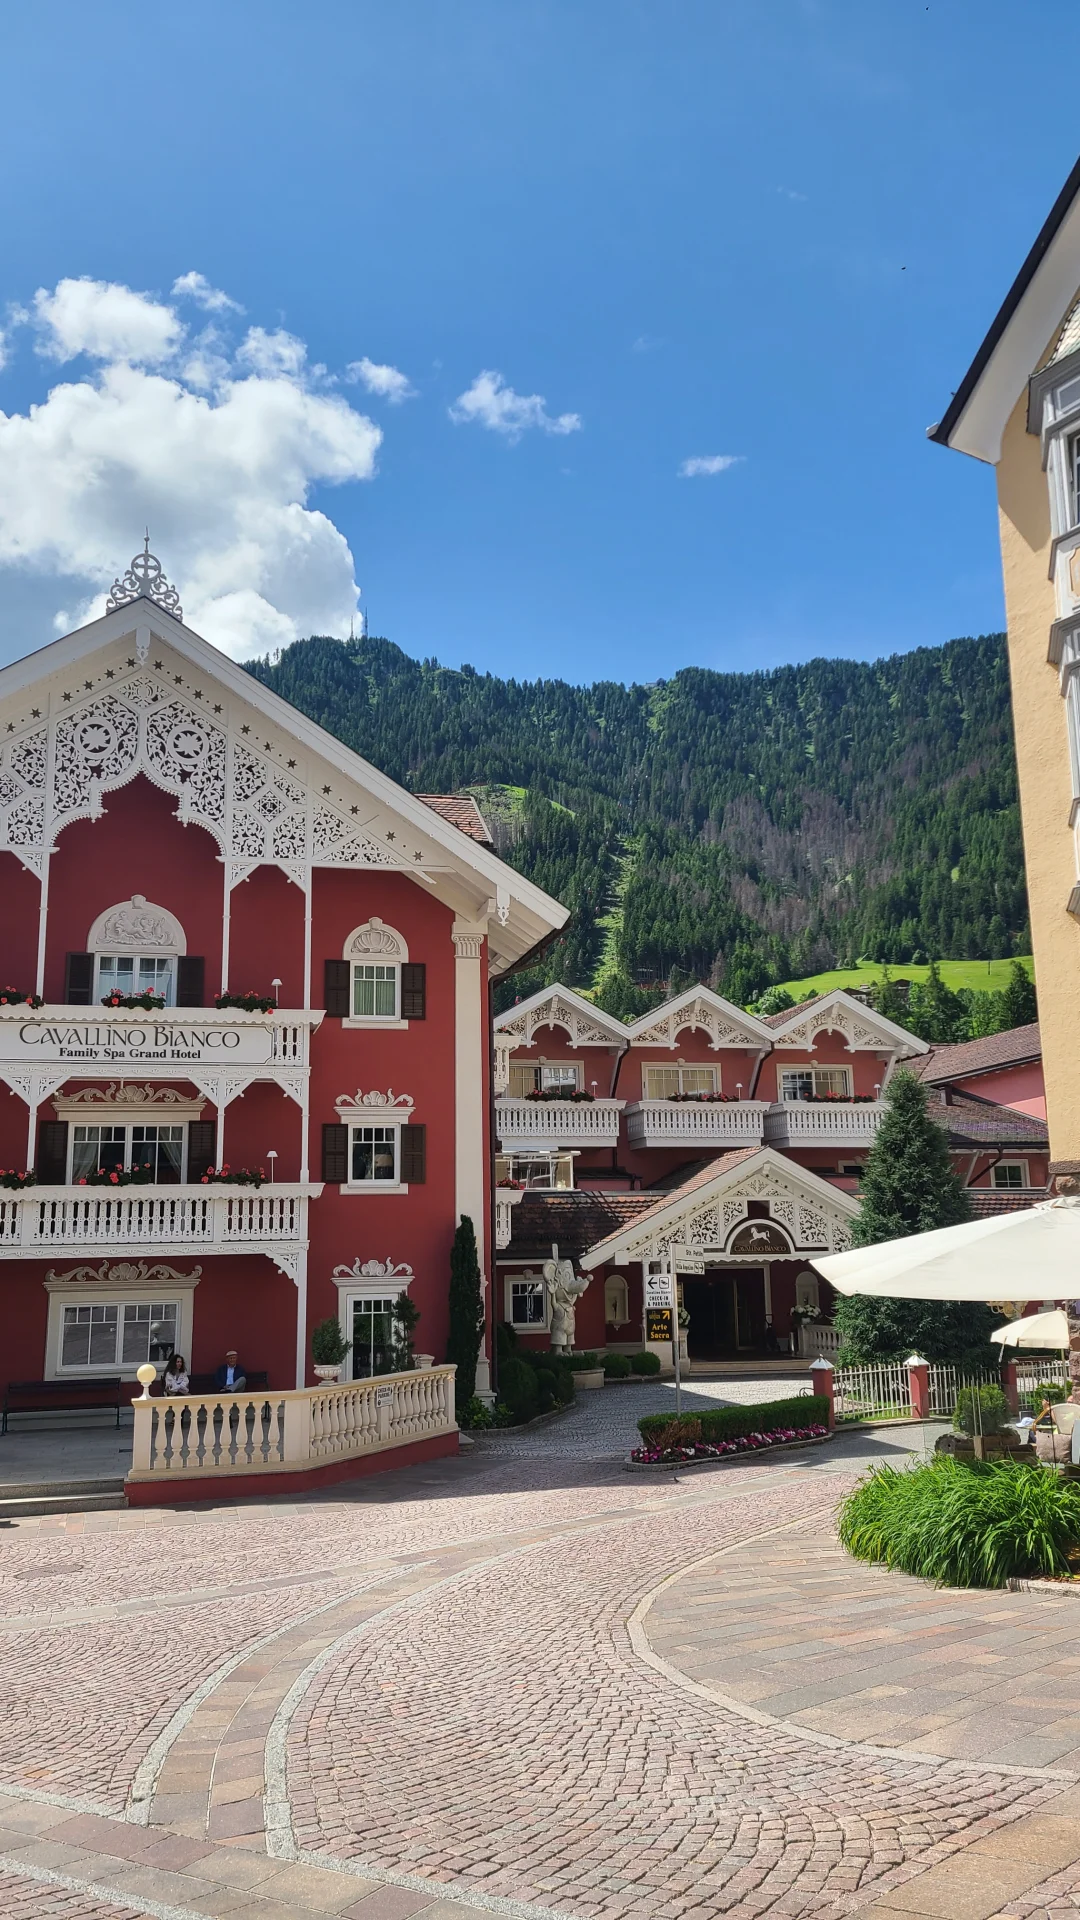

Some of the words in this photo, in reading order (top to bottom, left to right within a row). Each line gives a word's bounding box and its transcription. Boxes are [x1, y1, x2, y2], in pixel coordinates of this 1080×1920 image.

[59, 1047, 100, 1059] Family
[103, 1048, 125, 1059] Spa
[129, 1048, 167, 1059] Grand
[171, 1049, 201, 1059] Hotel
[650, 1331, 670, 1339] Sacra
